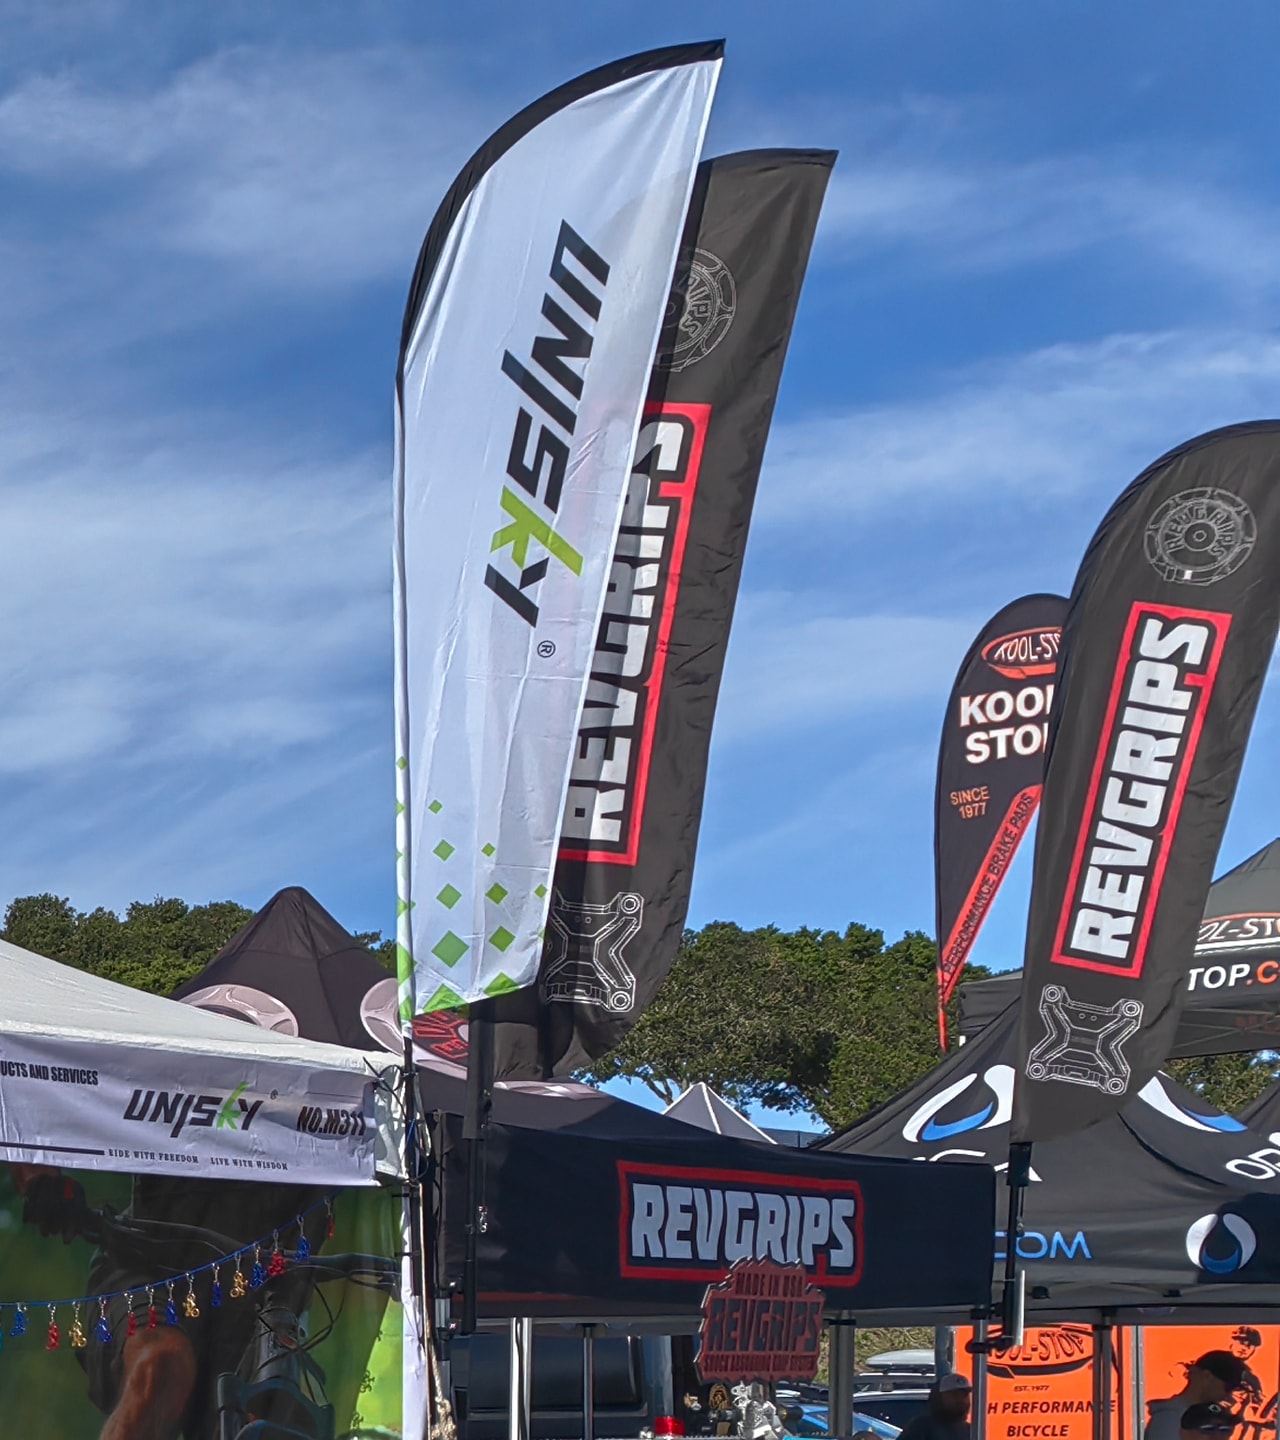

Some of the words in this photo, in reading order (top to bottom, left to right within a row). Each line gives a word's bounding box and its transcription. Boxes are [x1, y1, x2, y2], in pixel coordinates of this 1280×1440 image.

[950, 786, 990, 806] SINCE
[1070, 617, 1210, 959] REVGRIPS
[958, 802, 987, 820] 1977
[989, 825, 1020, 876] BRAKE
[1010, 791, 1035, 829] PADS
[29, 1064, 50, 1081] AND
[51, 1066, 99, 1086] SERVICES
[297, 1106, 367, 1137] NO.M311
[109, 1149, 130, 1159] RIDE
[134, 1151, 156, 1161] WITH
[158, 1152, 199, 1164] FREEDOM
[211, 1157, 230, 1166] LIVE
[232, 1158, 253, 1168] WITH
[256, 1160, 289, 1171] WISDOM
[631, 1182, 855, 1269] REVGRIPS
[707, 1300, 820, 1352] REVGRIPS
[1007, 1425, 1069, 1437] BICYCLE
